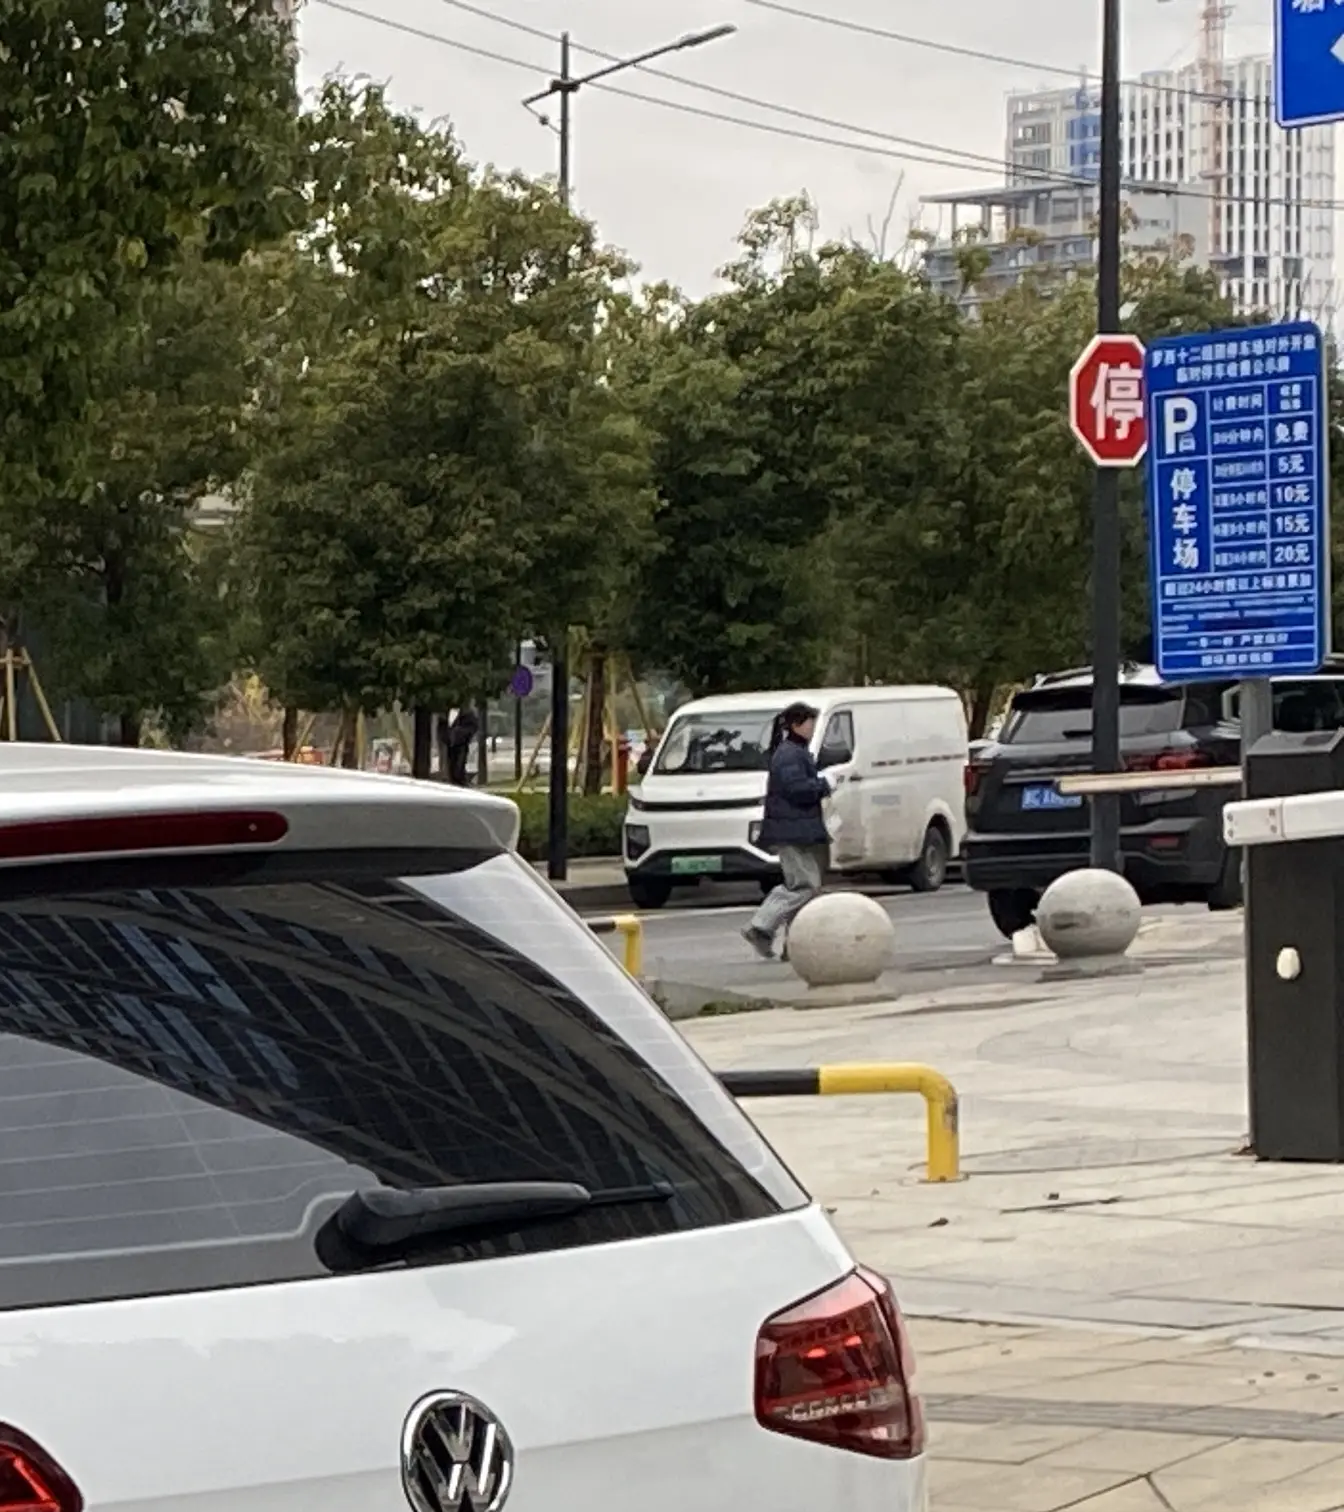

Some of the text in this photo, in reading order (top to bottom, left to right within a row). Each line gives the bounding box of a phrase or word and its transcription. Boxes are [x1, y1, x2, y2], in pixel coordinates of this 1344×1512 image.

[1090, 361, 1144, 440] 停
[1164, 397, 1198, 454] P
[1275, 421, 1309, 444] 免费
[1278, 453, 1305, 474] 5元
[1276, 483, 1310, 503] 10元
[1170, 467, 1200, 570] 停车场
[1276, 513, 1310, 534] 15元
[1274, 543, 1310, 564] 20元
